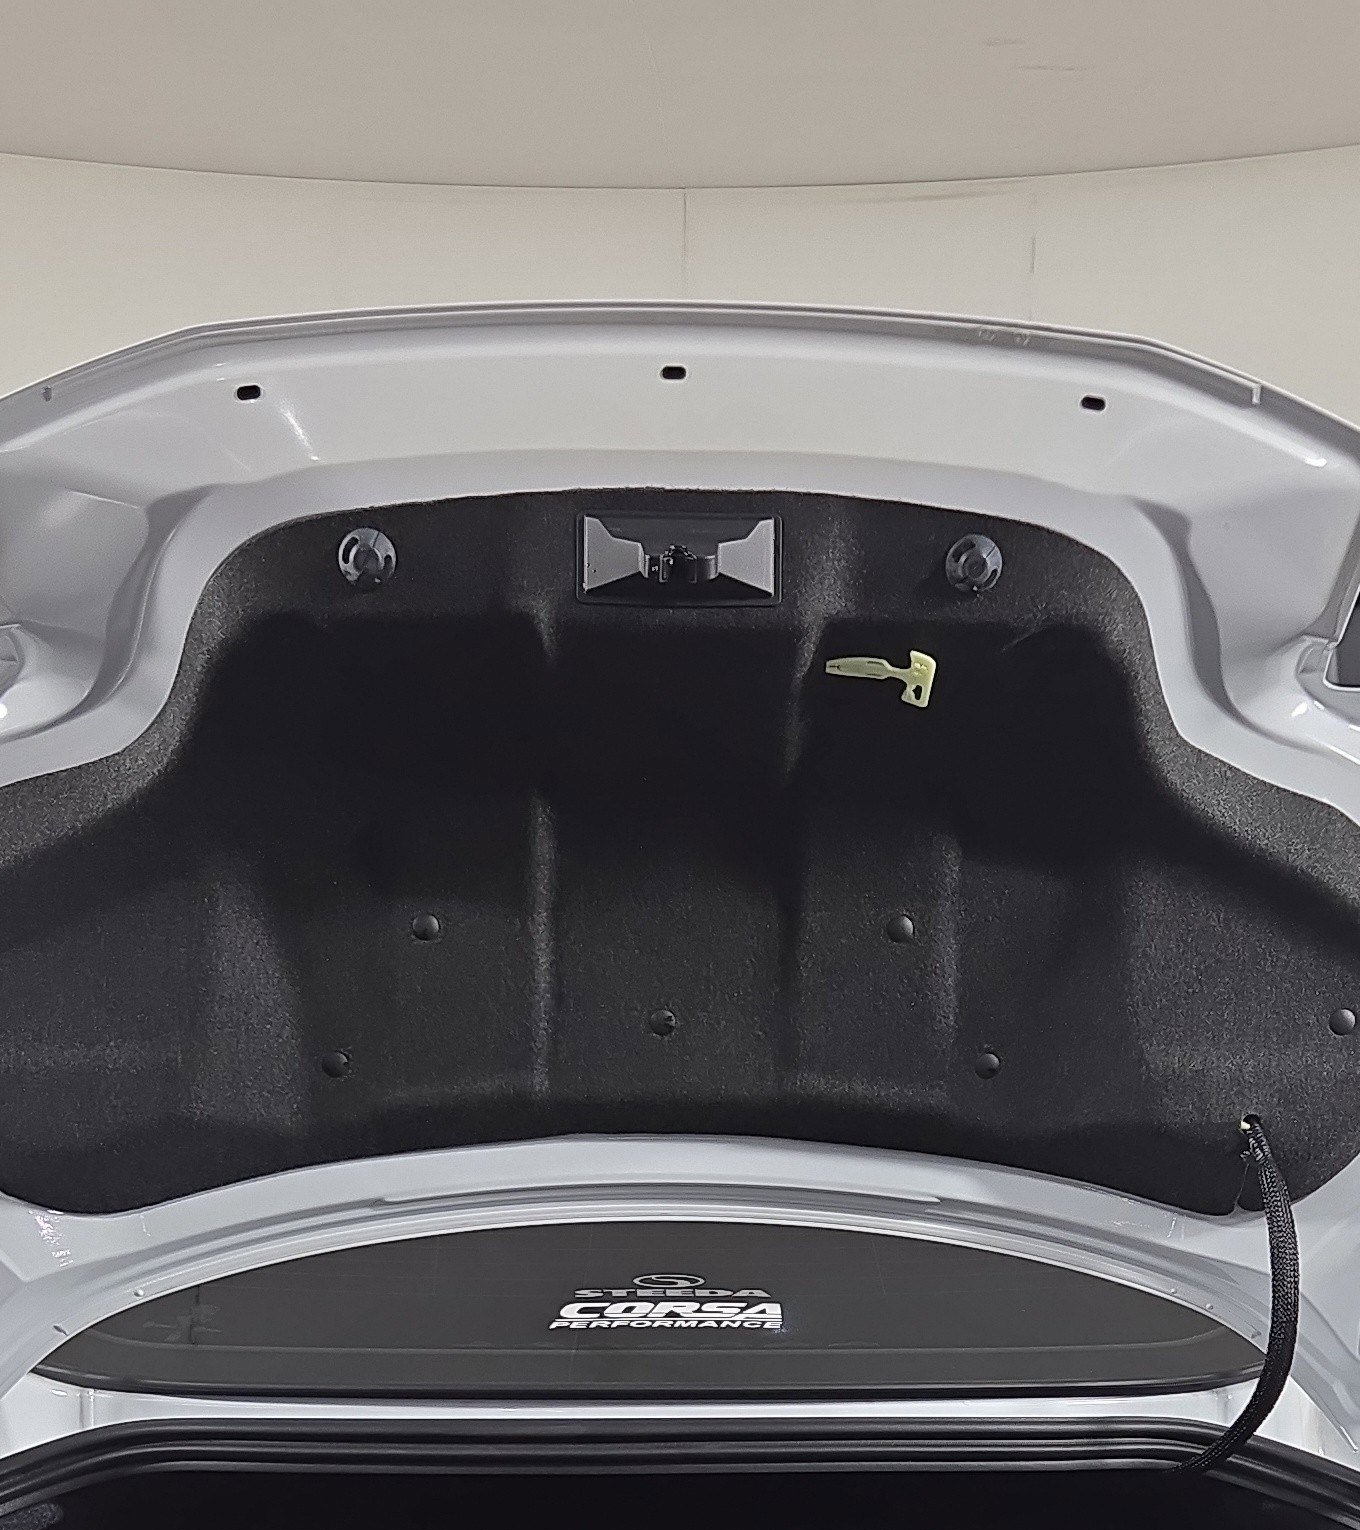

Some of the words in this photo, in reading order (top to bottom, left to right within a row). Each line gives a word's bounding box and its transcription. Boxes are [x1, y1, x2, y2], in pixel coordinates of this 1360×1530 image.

[574, 1288, 772, 1298] STEEDA
[559, 1301, 783, 1320] CORSA
[549, 1319, 783, 1330] PERFORMANCE
